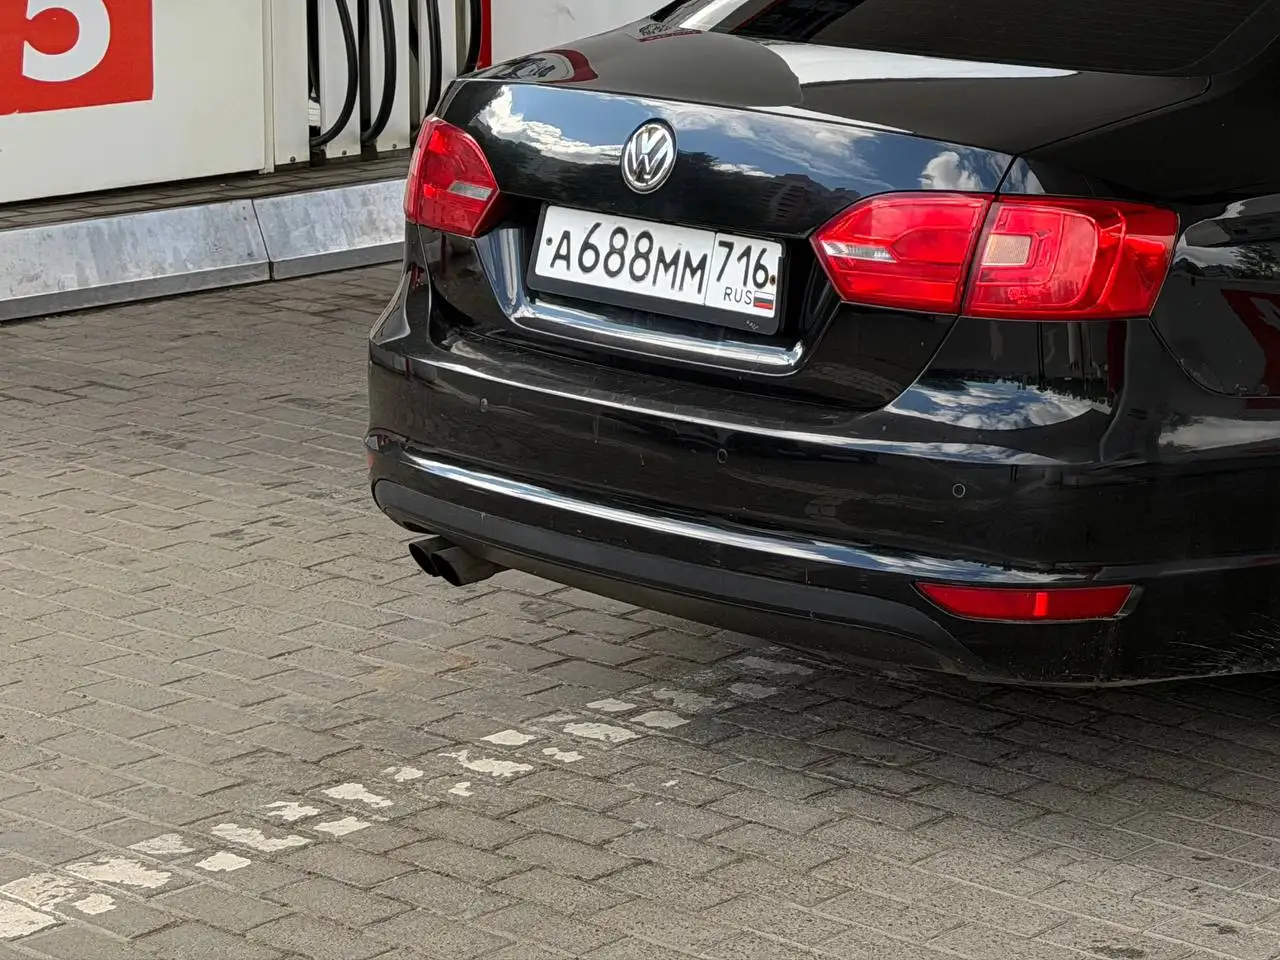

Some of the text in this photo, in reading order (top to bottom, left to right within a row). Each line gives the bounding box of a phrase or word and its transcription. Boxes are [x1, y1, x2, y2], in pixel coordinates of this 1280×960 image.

[549, 221, 771, 296] А688ММ 716
[722, 286, 752, 305] RUS
